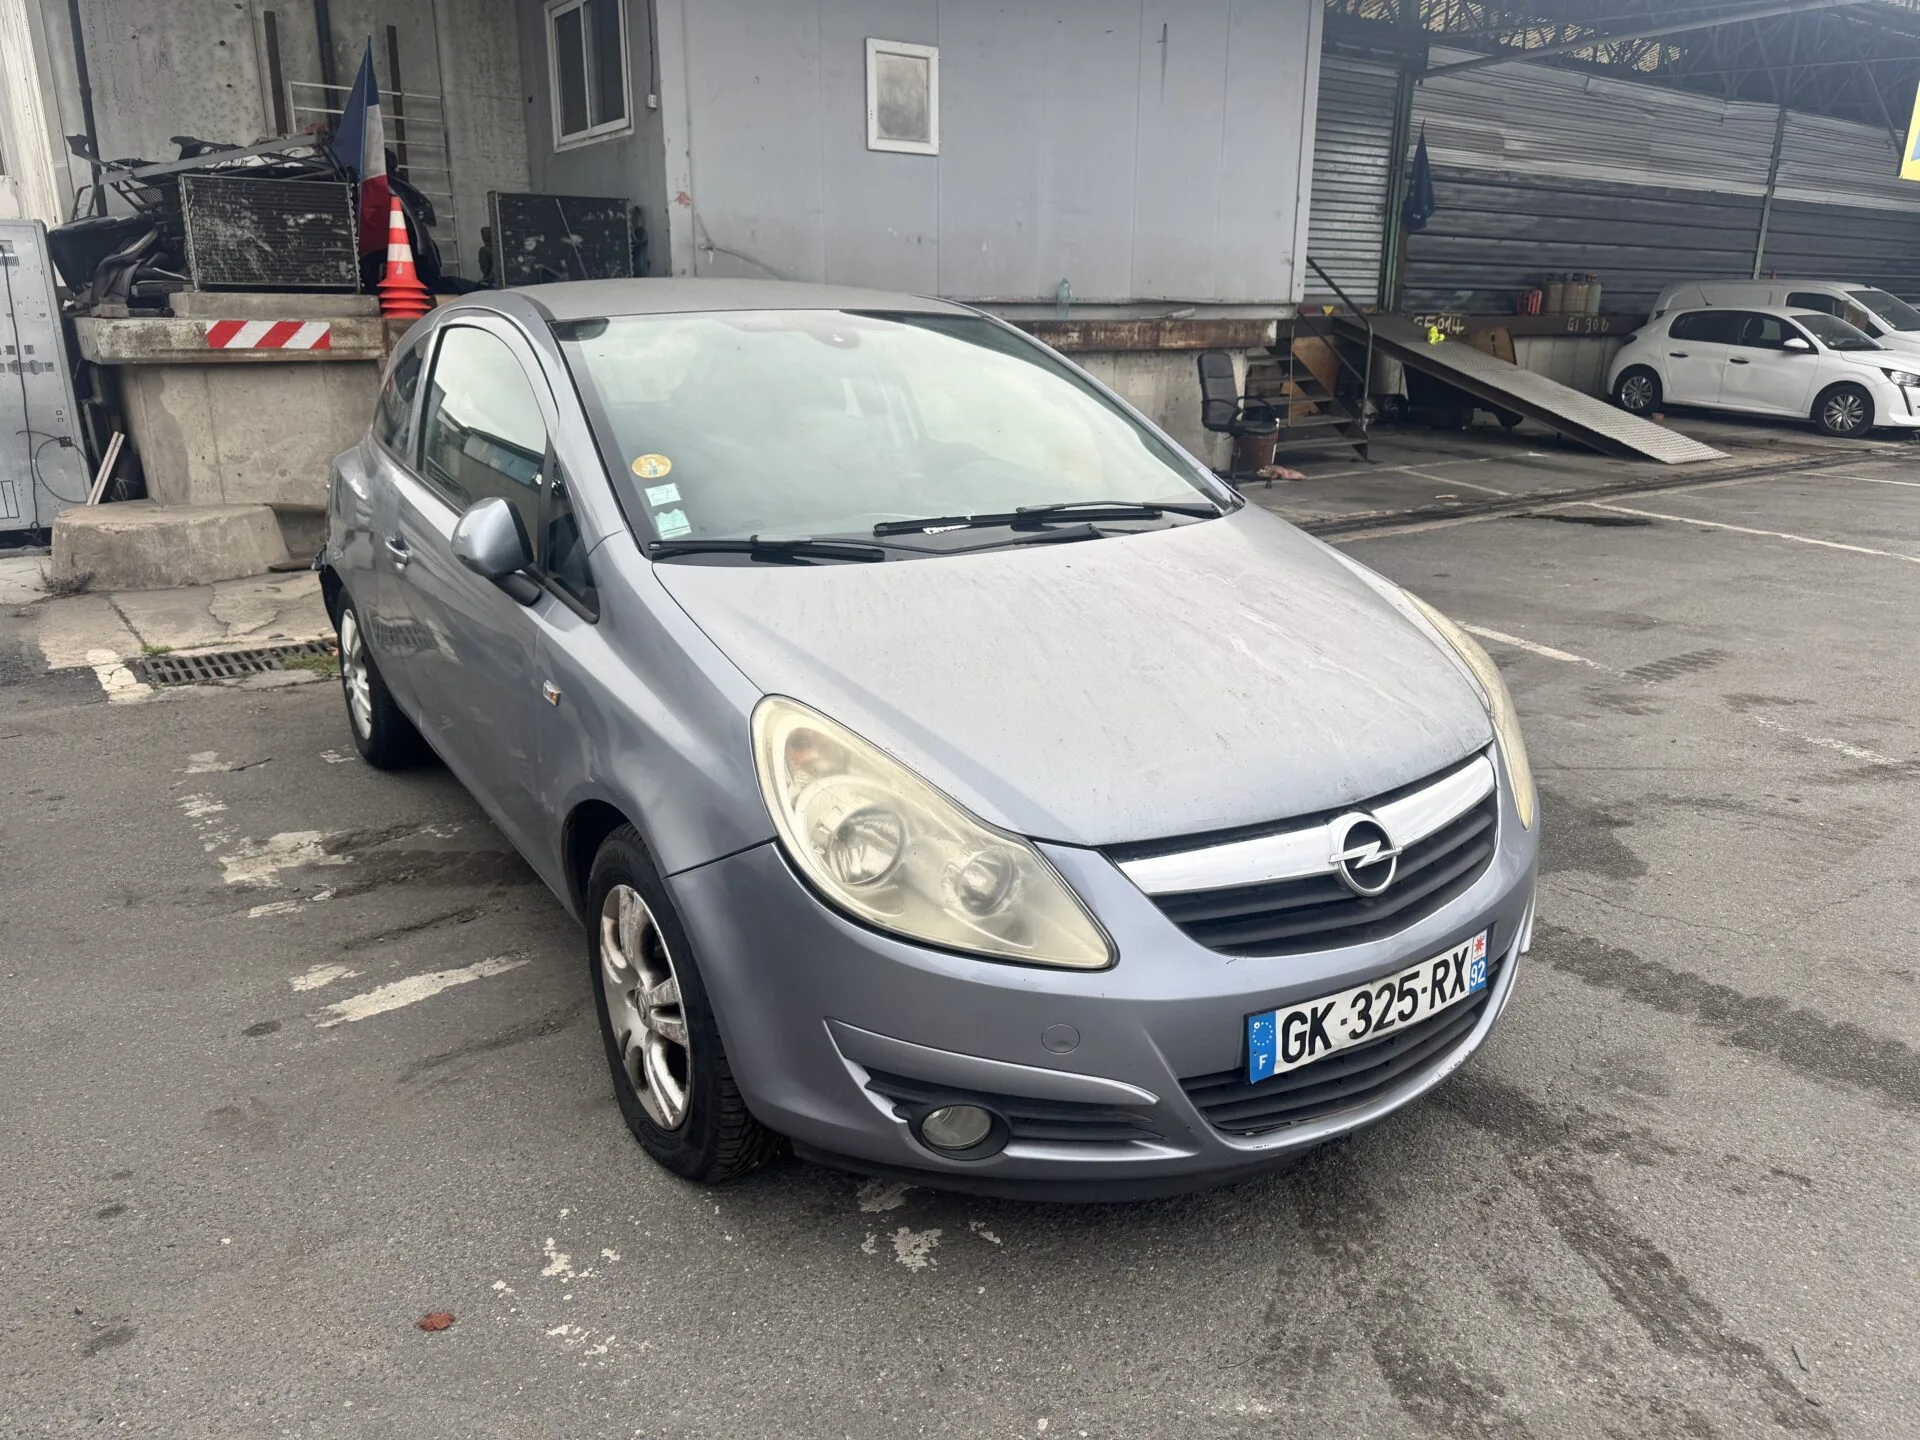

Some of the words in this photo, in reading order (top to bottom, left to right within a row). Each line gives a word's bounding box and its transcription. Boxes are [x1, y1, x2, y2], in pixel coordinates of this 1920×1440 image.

[1470, 961, 1486, 987] 92
[1281, 946, 1469, 1064] GK-325-RX
[1258, 1054, 1268, 1070] F
